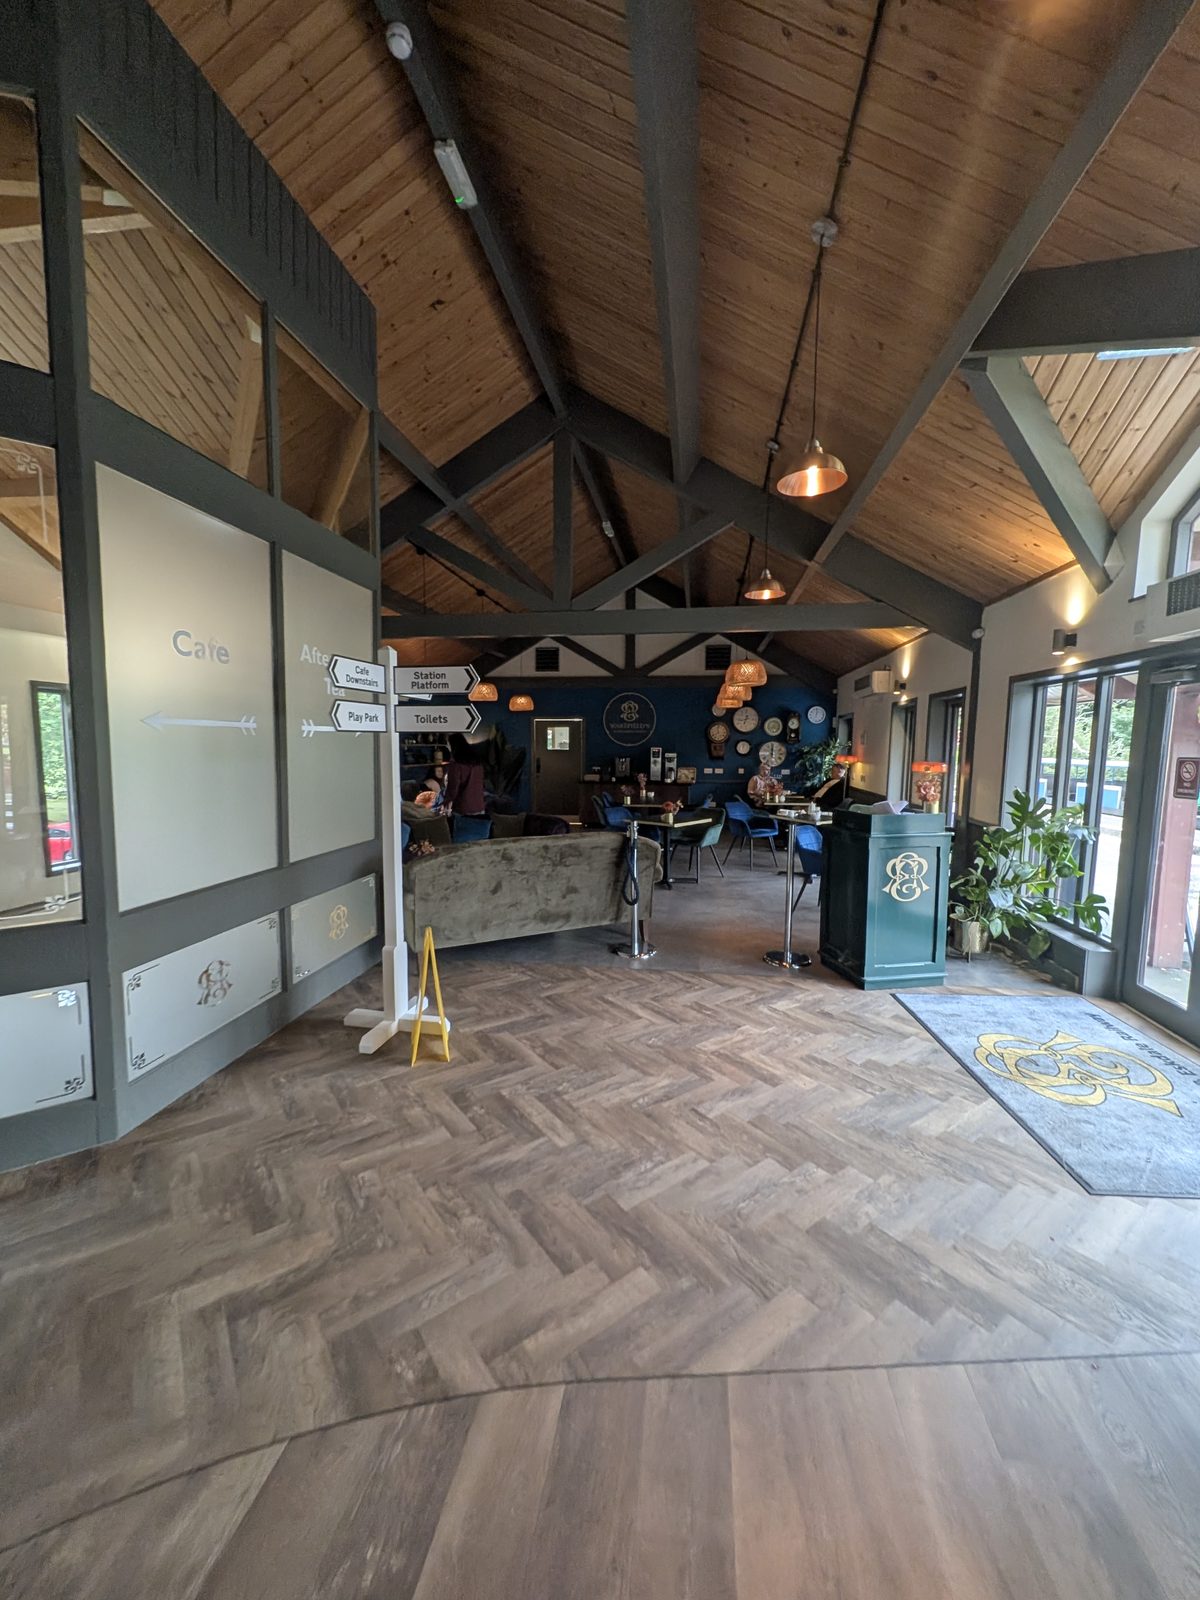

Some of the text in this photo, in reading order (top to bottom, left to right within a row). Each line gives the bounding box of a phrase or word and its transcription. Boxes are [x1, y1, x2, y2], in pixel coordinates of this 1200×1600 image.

[172, 630, 230, 664] Cafe
[300, 644, 330, 667] Afte
[355, 665, 370, 676] Cafe
[413, 671, 447, 681] Station
[345, 674, 379, 688] Downstairs
[411, 681, 449, 690] Platform
[348, 711, 379, 723] Play Park
[414, 714, 448, 724] Toilets
